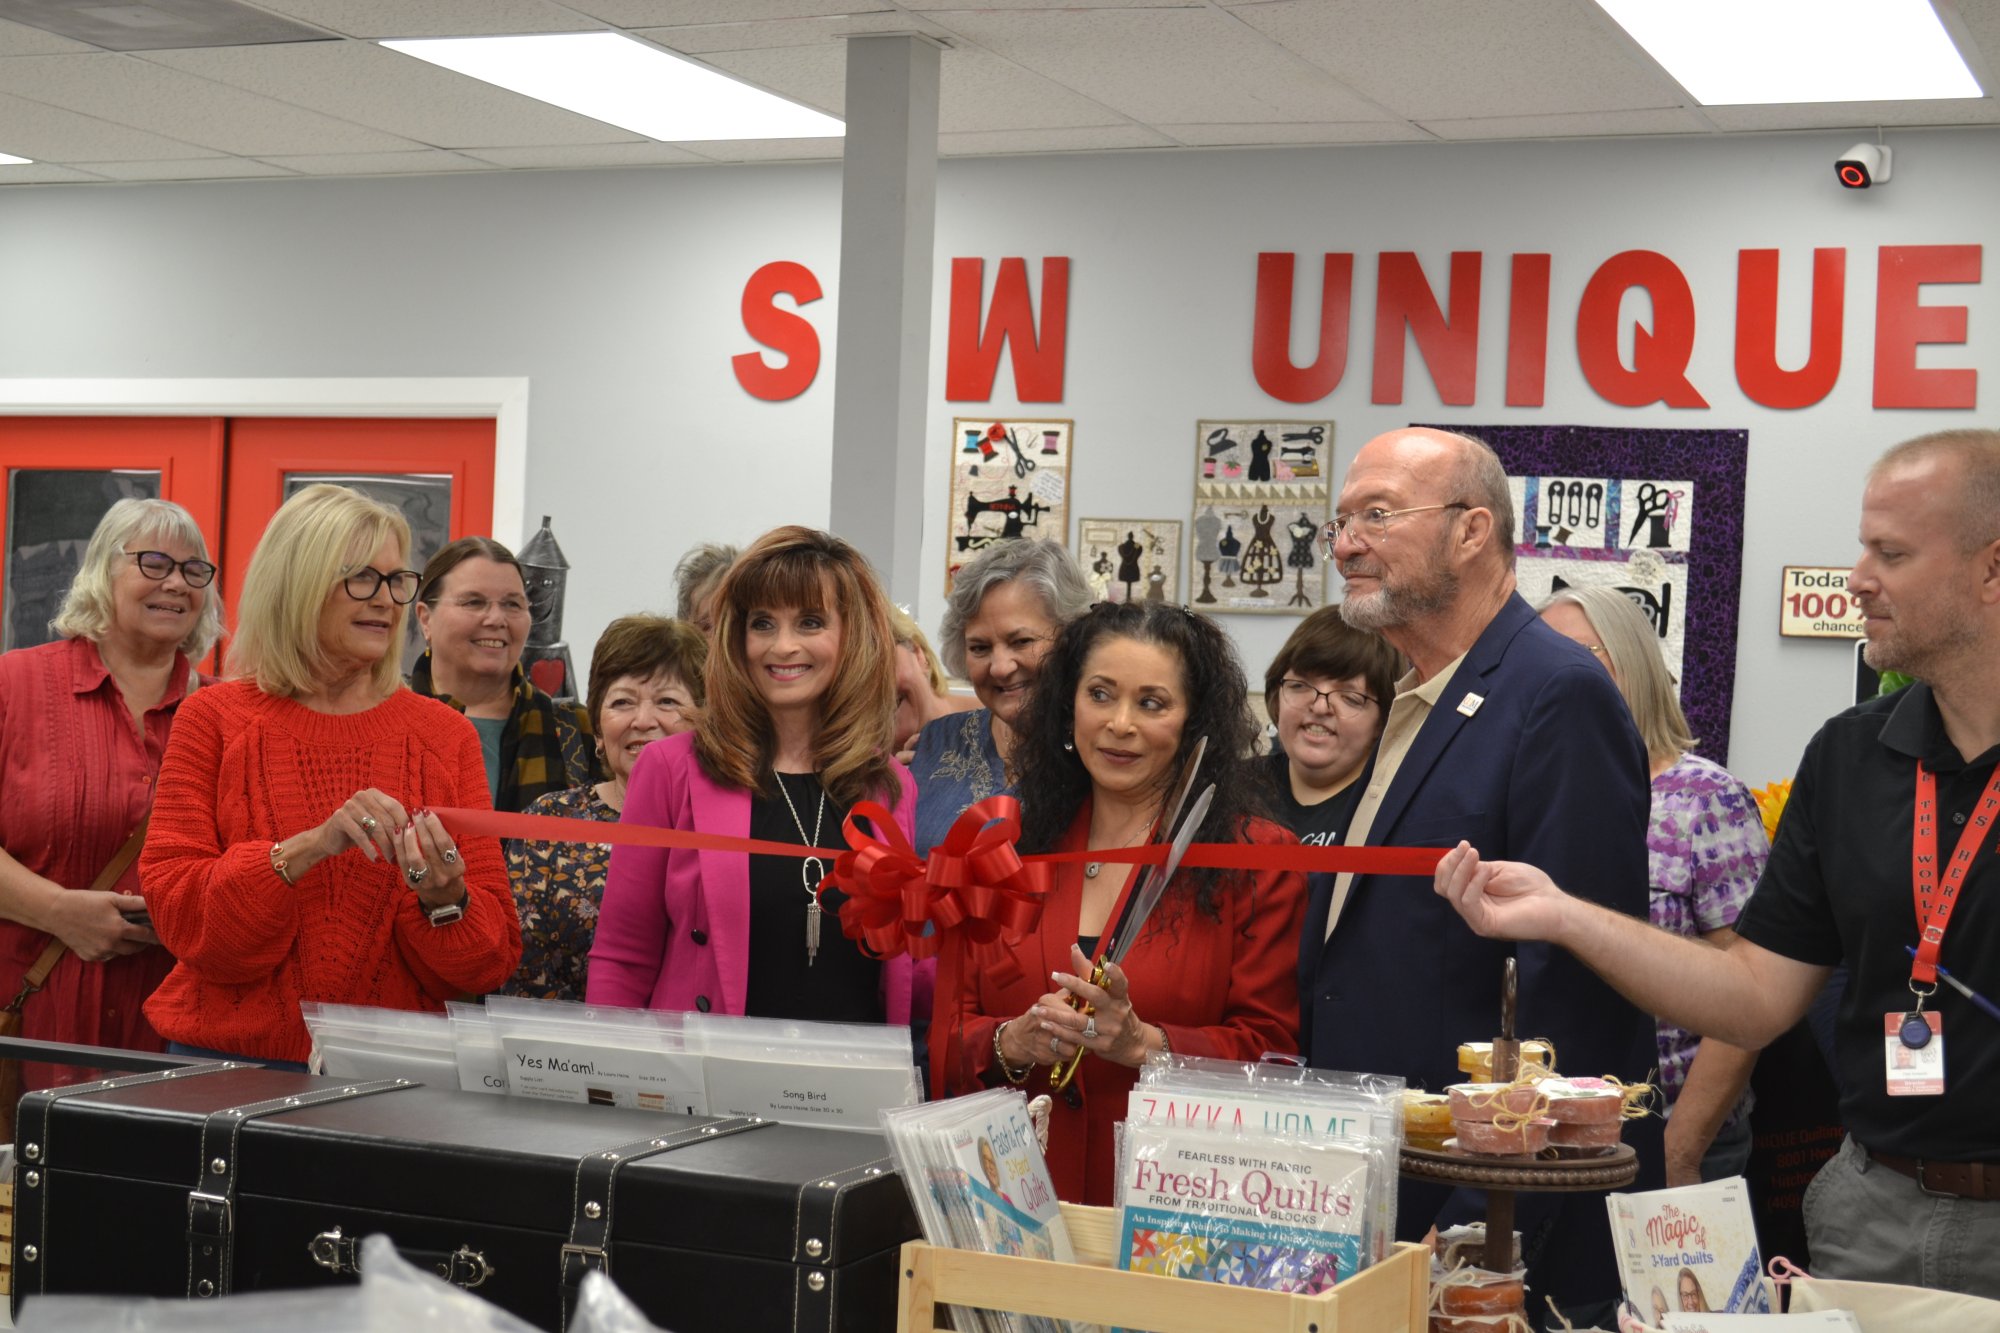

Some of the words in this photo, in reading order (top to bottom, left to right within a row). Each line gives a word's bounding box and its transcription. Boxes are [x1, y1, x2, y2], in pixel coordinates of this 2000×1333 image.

[731, 256, 1071, 404] SW
[1252, 244, 1983, 411] UNIQUE
[1813, 620, 1864, 632] chance
[1920, 800, 1931, 836] THE
[1937, 850, 1970, 916] HERE
[516, 1053, 543, 1070] Yes
[548, 1057, 595, 1075] Ma'am!
[783, 1090, 805, 1101] Song
[807, 1091, 827, 1101] Bird
[1178, 1150, 1235, 1166] FEARLESS
[1239, 1157, 1267, 1169] WITH
[1271, 1161, 1312, 1175] FABRIC
[1020, 1172, 1050, 1213] Quilts
[1132, 1158, 1230, 1202] Fresh
[1241, 1169, 1351, 1216] Quilts
[1149, 1195, 1182, 1209] FROM
[1185, 1199, 1259, 1218] TRADITIONAL
[1271, 1211, 1317, 1226] BLOCKS
[1662, 1204, 1679, 1220] The
[1132, 1213, 1145, 1224] An
[1147, 1215, 1189, 1232] Inspiring
[1191, 1219, 1218, 1233] Guide
[1231, 1225, 1266, 1240] Making
[1305, 1236, 1344, 1251] Projects
[1646, 1214, 1698, 1249] Magic
[1694, 1226, 1706, 1249] of
[1652, 1254, 1679, 1268] 3-Yard
[1682, 1252, 1714, 1266] Quilts
